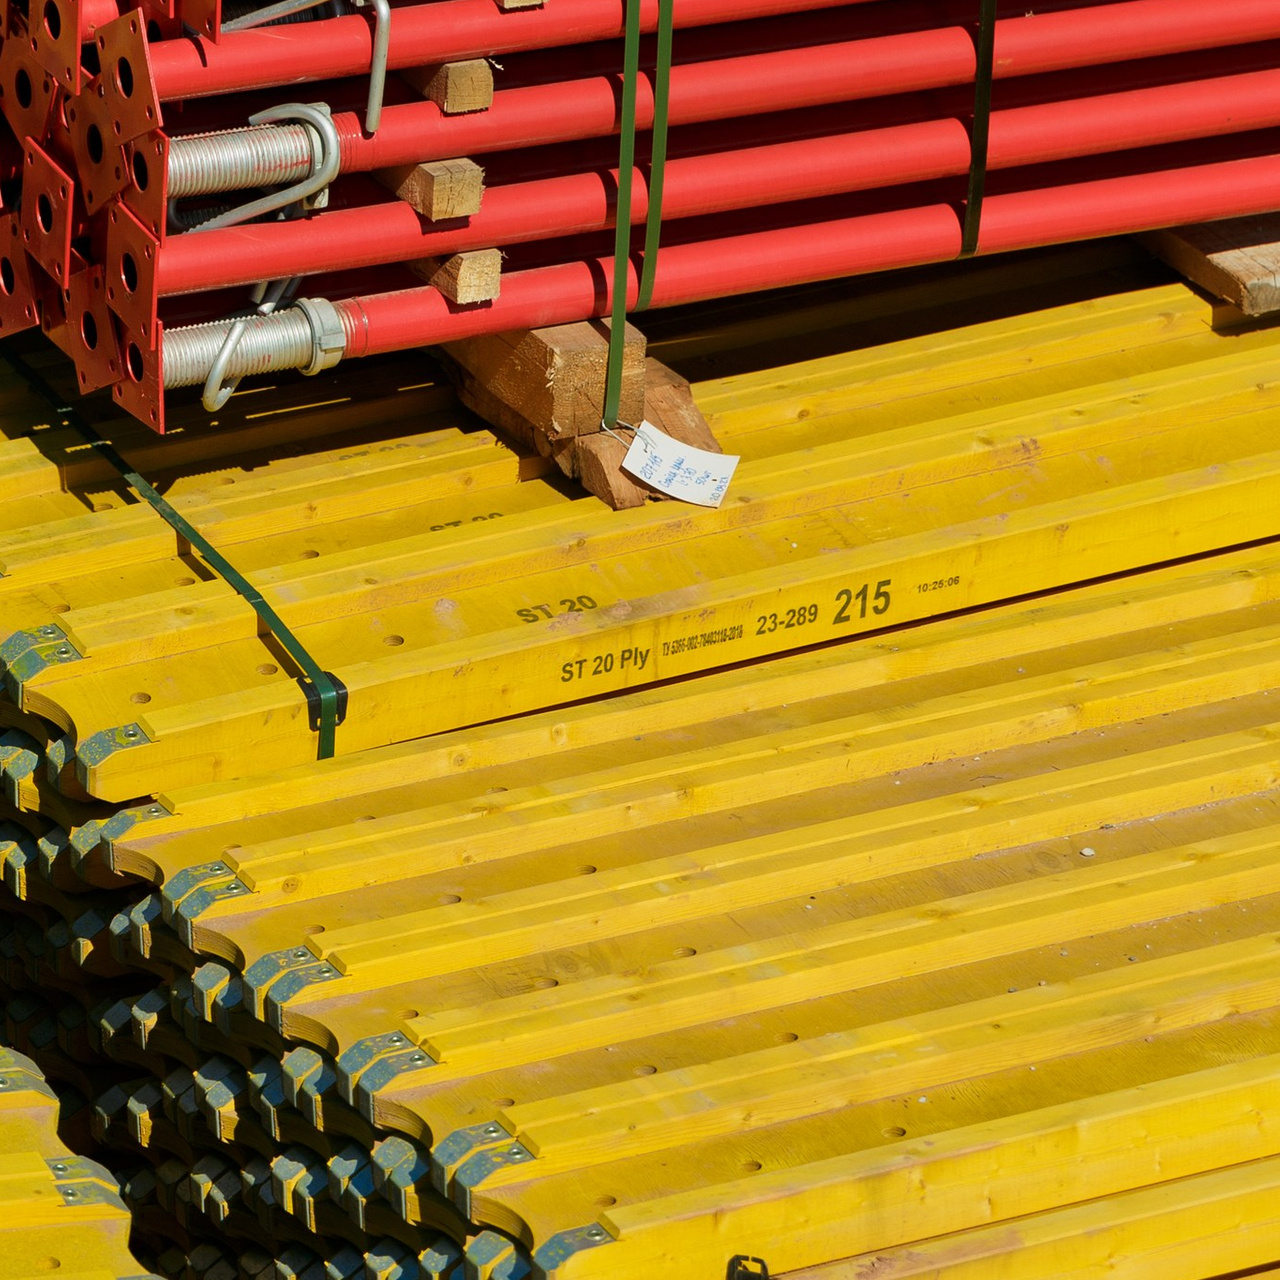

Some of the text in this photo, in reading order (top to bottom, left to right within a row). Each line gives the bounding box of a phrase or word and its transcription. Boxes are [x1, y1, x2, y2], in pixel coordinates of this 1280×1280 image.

[516, 595, 598, 623] ST 20
[561, 659, 587, 682] ST
[592, 653, 614, 676] 20
[620, 647, 651, 670] Ply
[756, 604, 818, 635] 23-289
[832, 579, 892, 625] 215
[917, 576, 960, 593] 10:25:06
